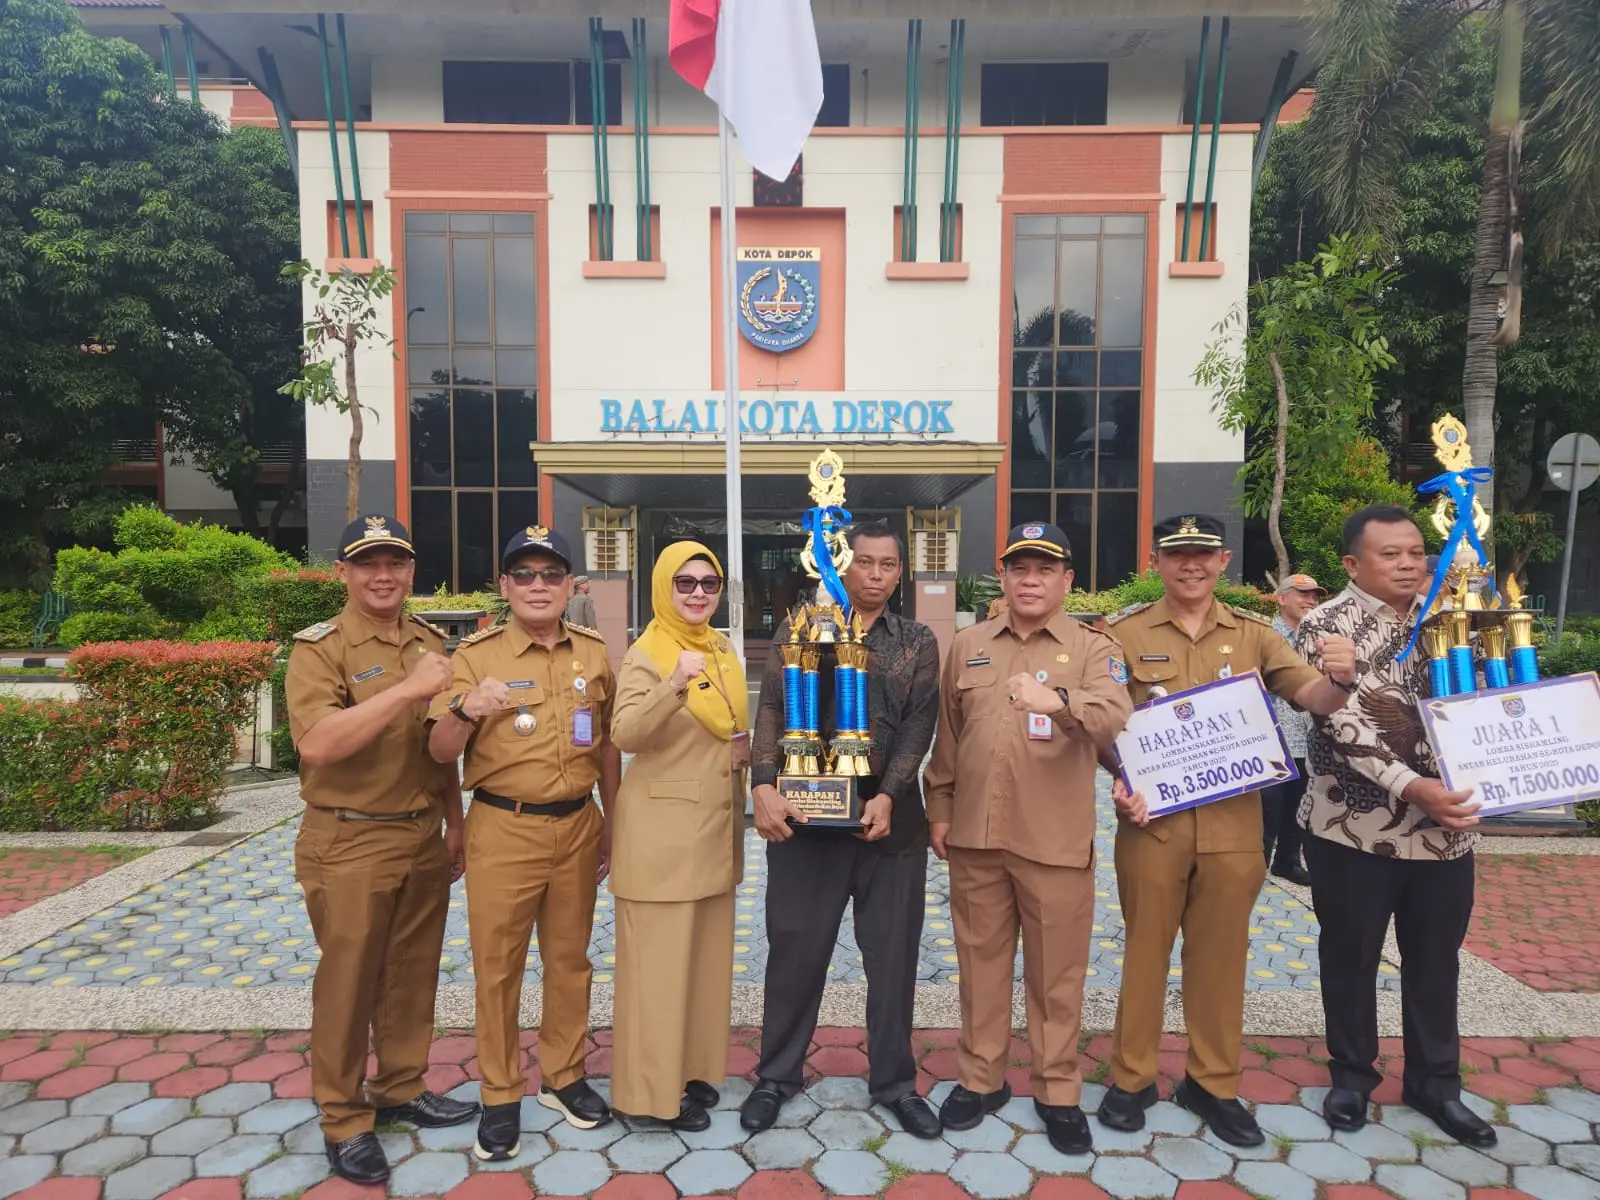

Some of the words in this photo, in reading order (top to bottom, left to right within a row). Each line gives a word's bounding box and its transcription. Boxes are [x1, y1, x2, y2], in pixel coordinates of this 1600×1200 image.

[744, 249, 772, 259] KOTA
[777, 249, 814, 259] DEPOK
[600, 399, 718, 432] BALAI
[832, 400, 954, 434] DEPOK
[1138, 711, 1233, 754] HARAPAN
[1472, 717, 1544, 746] JUARA
[1549, 714, 1561, 733] 1
[1161, 746, 1188, 759] LOMBA
[1187, 734, 1236, 752] SISKAMLING
[1162, 750, 1209, 769] KELURAHAN
[1240, 733, 1269, 747] DEPOK
[1457, 761, 1486, 772] ANTAR
[1486, 752, 1539, 767] KELURAHAN
[1575, 740, 1600, 751] DEPO
[1485, 745, 1515, 756] LOMBA
[1515, 736, 1569, 751] SISKAMLING
[1183, 760, 1210, 773] TAHUN
[1508, 762, 1538, 774] TAHUN
[786, 791, 834, 799] HARAPAN
